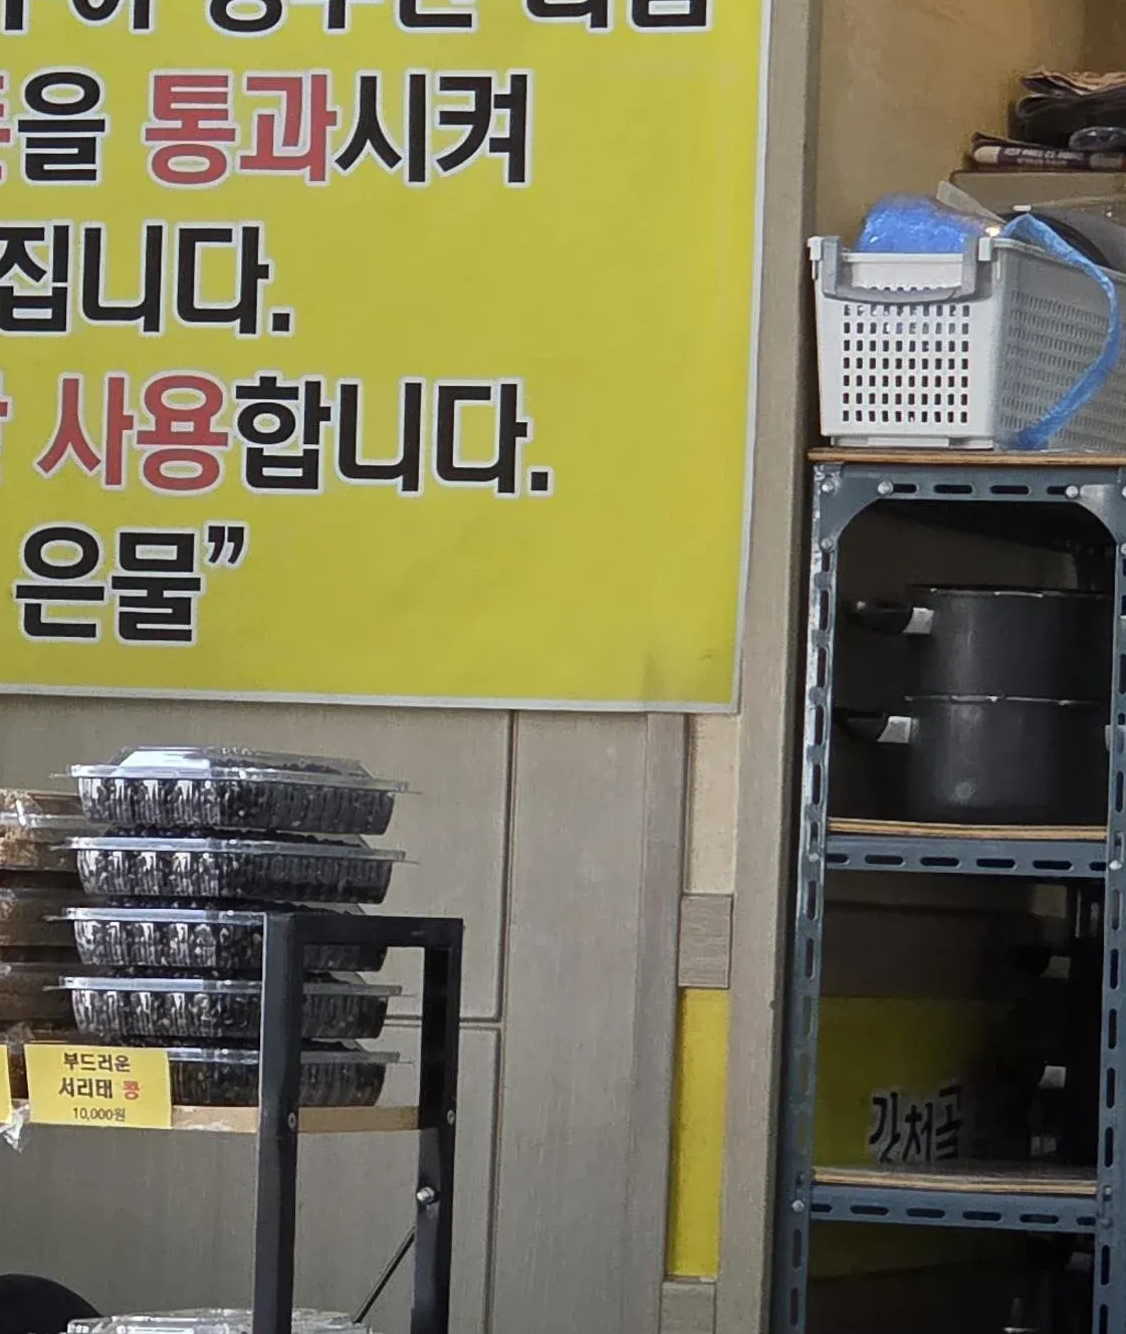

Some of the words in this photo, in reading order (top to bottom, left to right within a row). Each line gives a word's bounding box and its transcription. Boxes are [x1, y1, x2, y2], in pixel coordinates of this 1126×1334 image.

[146, 75, 527, 183] 통과시켜
[41, 376, 548, 493] 사용합니다.
[16, 526, 244, 641] 은물”
[58, 1077, 113, 1099] 서리태
[63, 1052, 131, 1073] 부드러운
[73, 1107, 126, 1122] 10,000원
